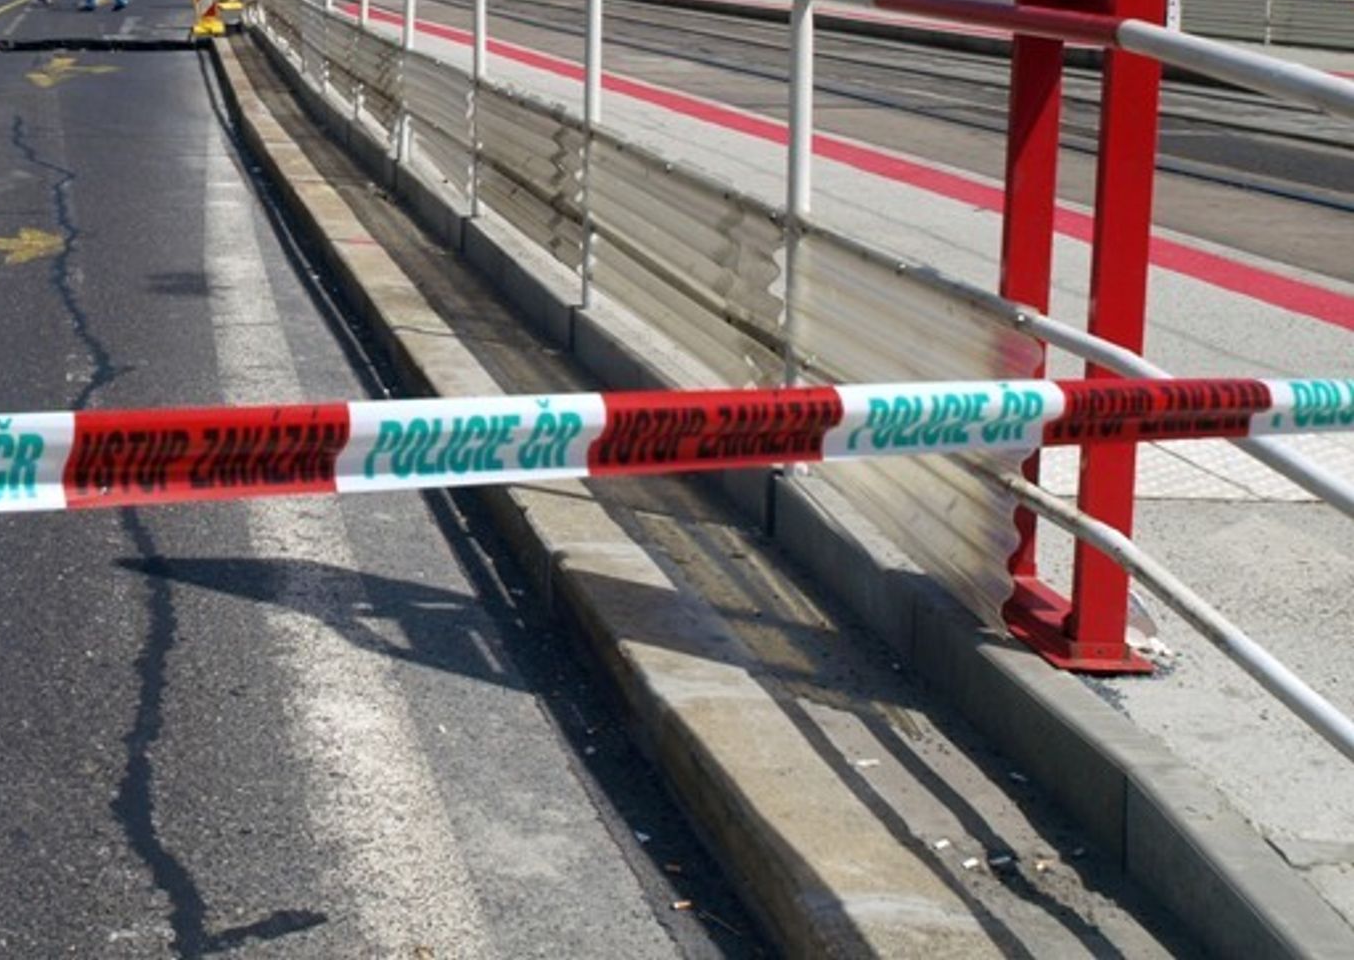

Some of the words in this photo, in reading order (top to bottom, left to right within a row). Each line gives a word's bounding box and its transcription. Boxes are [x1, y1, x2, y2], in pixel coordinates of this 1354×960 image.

[73, 429, 191, 495] VSTUP
[364, 414, 521, 479] POLICIE
[517, 398, 584, 470] ČR
[847, 392, 990, 450] POLICIE
